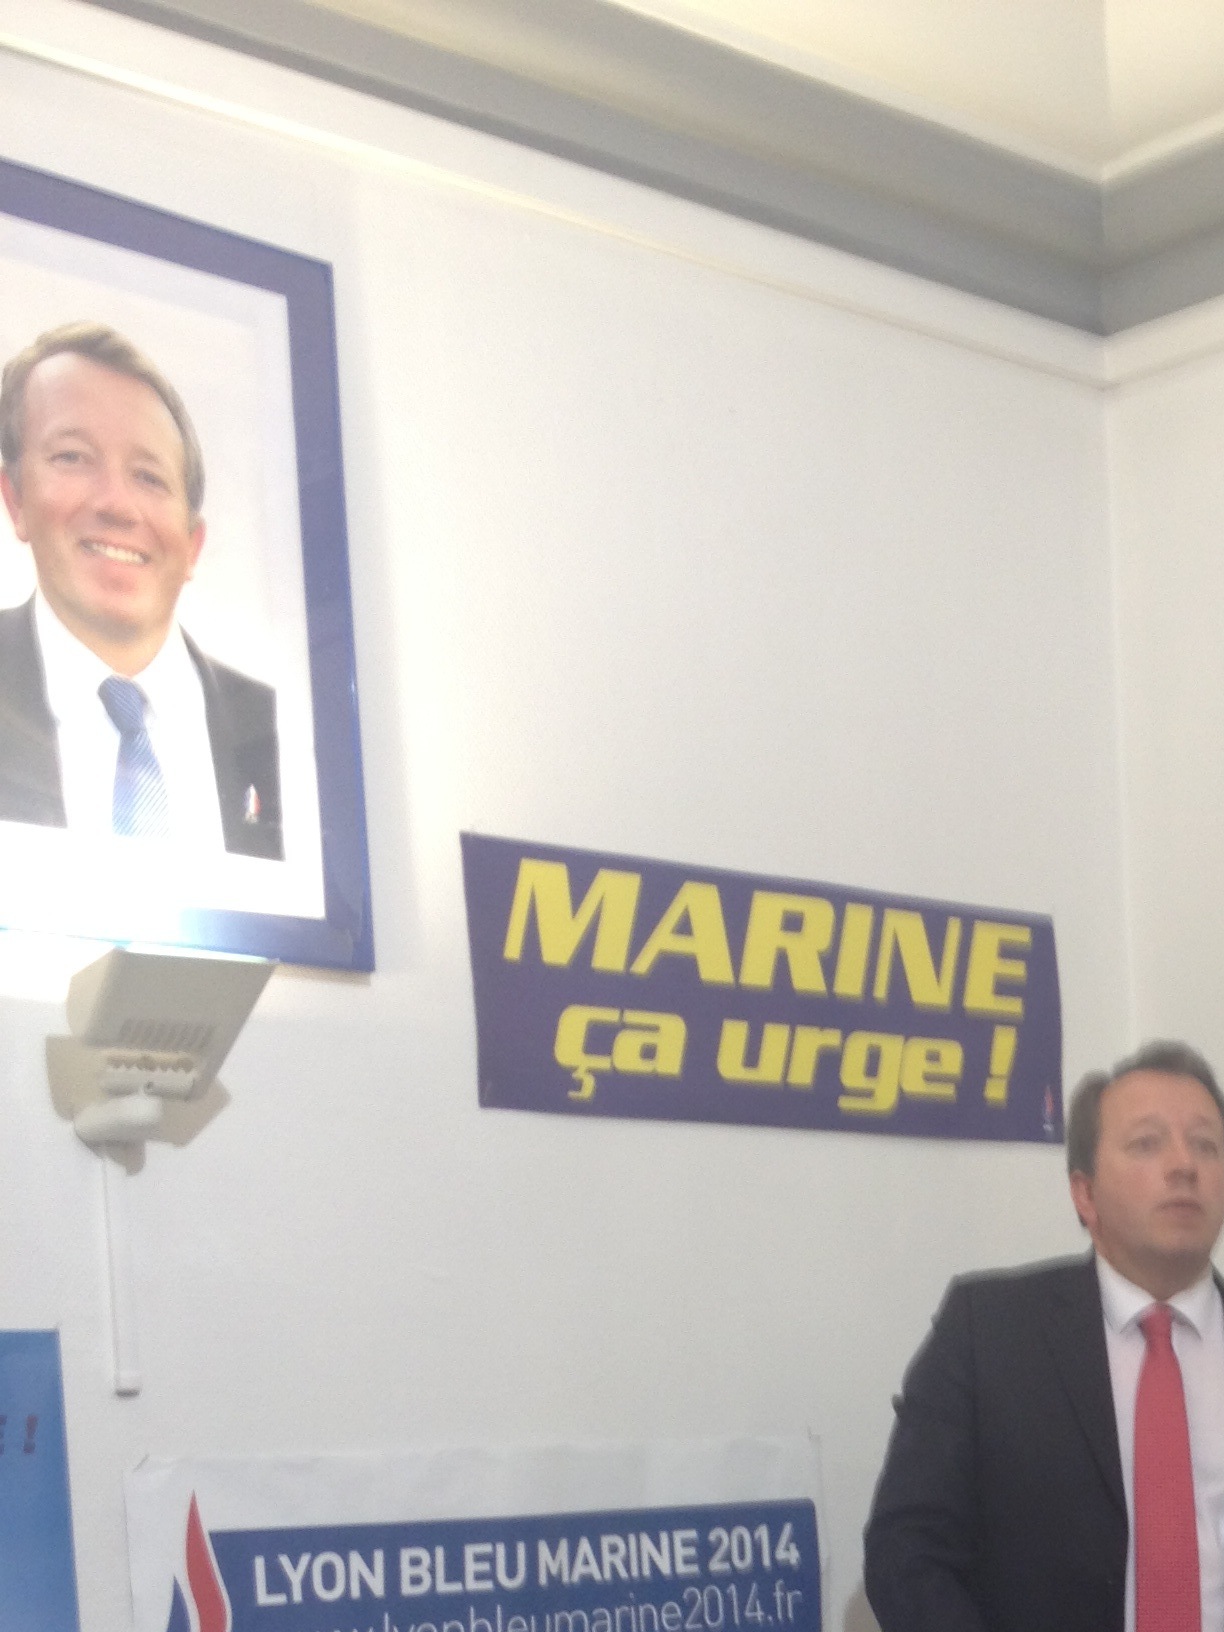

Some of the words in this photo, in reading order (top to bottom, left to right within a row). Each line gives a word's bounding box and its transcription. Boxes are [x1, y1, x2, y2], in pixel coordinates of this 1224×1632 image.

[503, 857, 1032, 1020] MARINE
[554, 1003, 688, 1100] ça
[717, 1018, 963, 1115] urge
[254, 1550, 385, 1606] LYON
[400, 1540, 527, 1597] BLEU
[537, 1529, 699, 1588] MARINE
[707, 1521, 801, 1574] 2014
